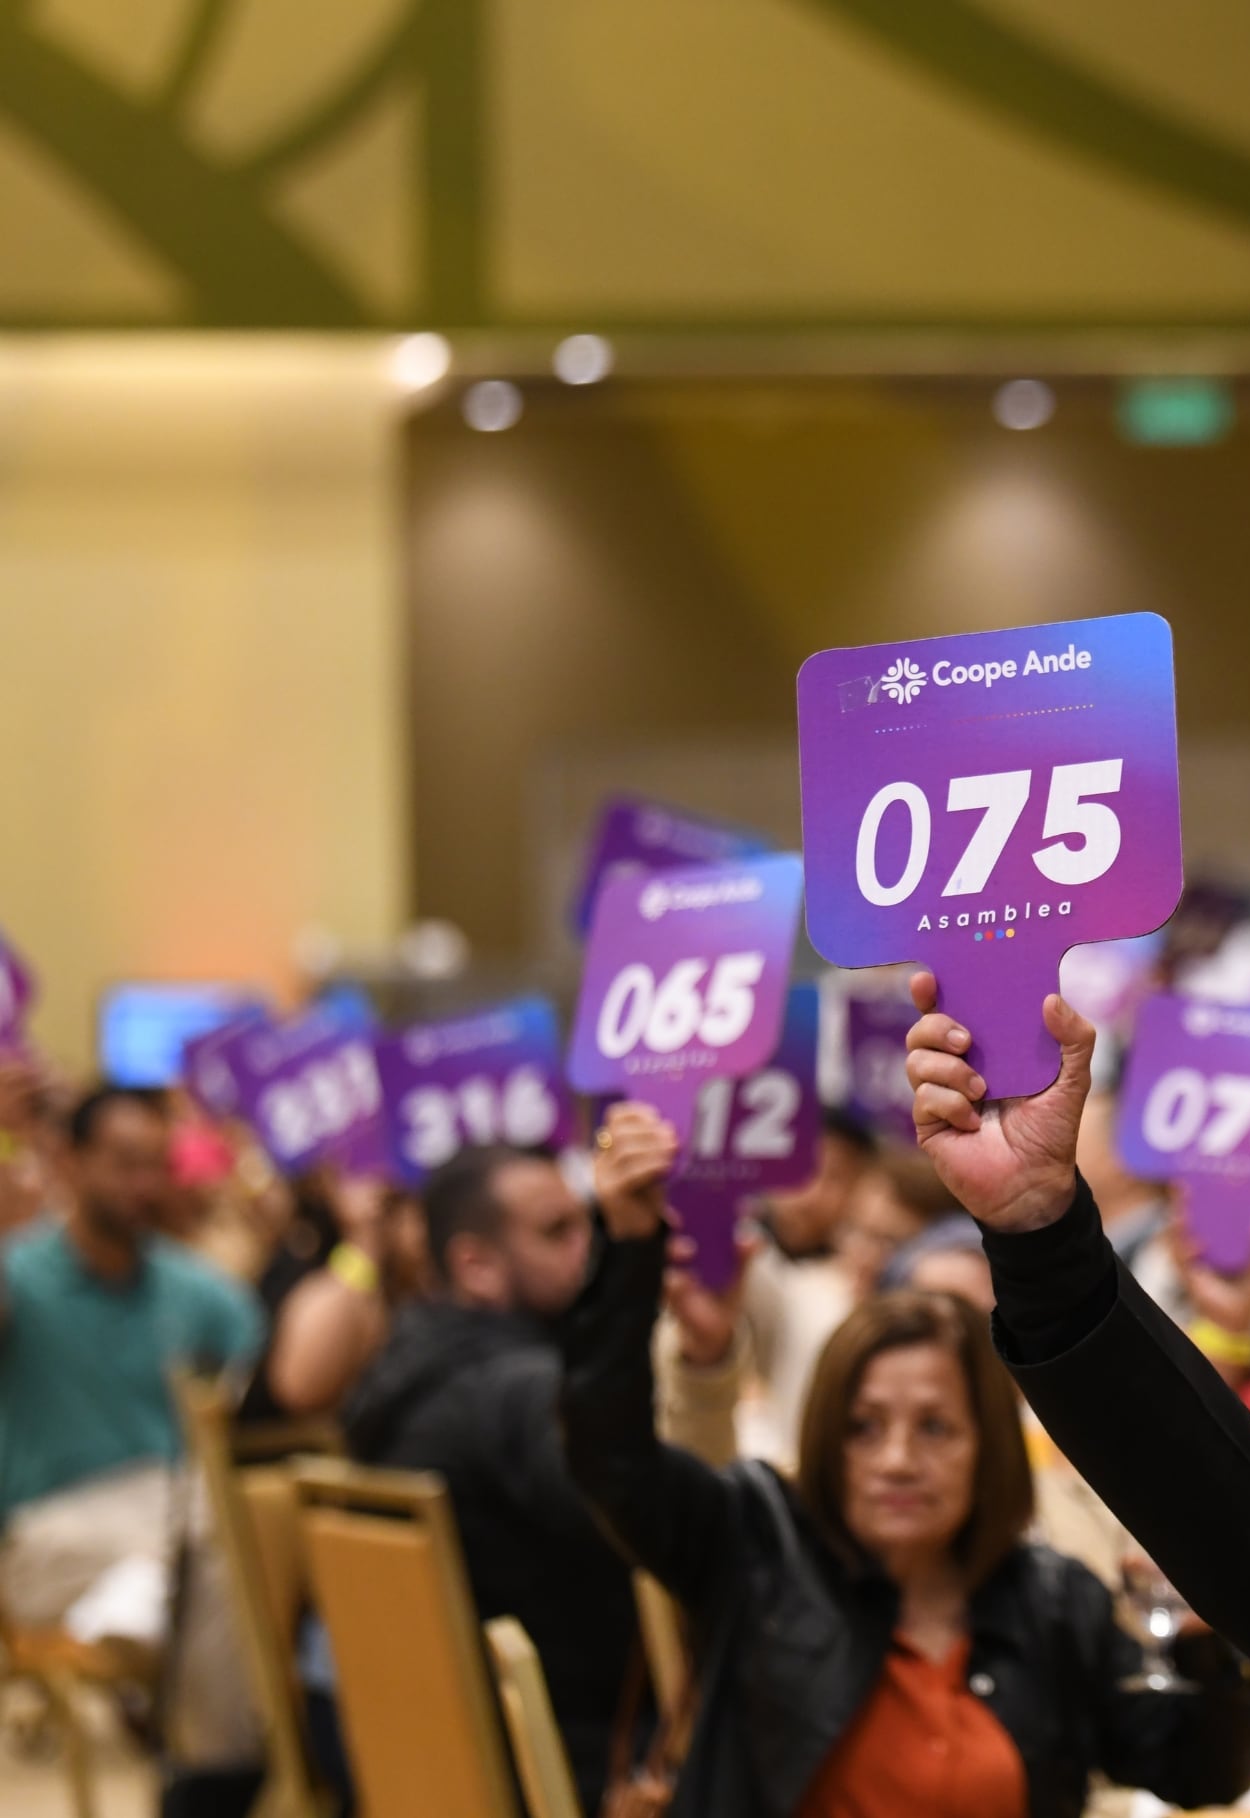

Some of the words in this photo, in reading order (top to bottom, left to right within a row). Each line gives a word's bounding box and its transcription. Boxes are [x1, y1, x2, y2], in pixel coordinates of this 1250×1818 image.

[932, 657, 1017, 688] Coope
[1022, 644, 1092, 677] Ande
[855, 758, 1124, 907] 075
[917, 900, 1073, 931] Asamblea
[597, 951, 766, 1059] 065
[401, 1065, 558, 1169] 316
[697, 1067, 800, 1159] 12
